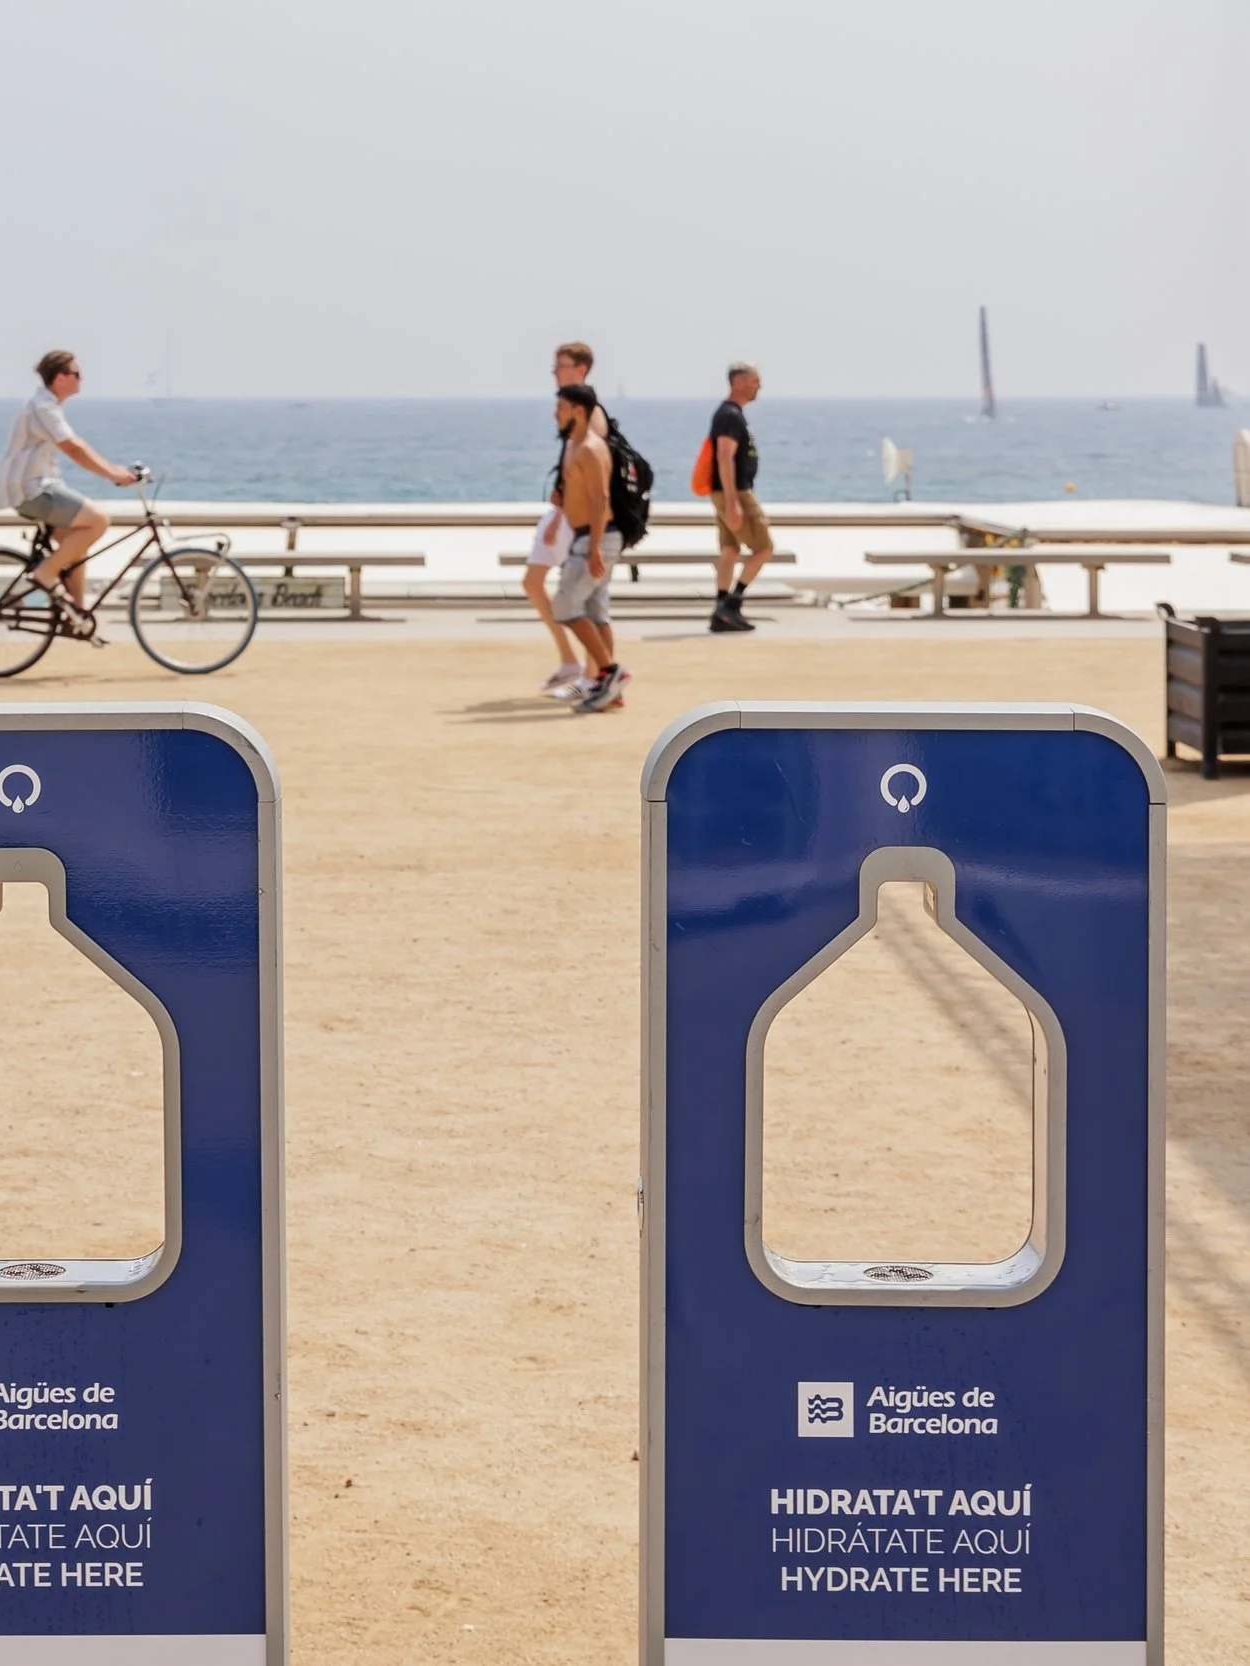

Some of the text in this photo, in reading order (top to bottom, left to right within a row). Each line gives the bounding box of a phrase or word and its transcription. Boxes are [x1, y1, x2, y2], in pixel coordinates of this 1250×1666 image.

[82, 1382, 116, 1404] de
[867, 1386, 996, 1414] Aigües de
[868, 1413, 999, 1435] Barcelona
[69, 1477, 153, 1512] AQUÍ
[770, 1483, 1033, 1517] HIDRATA'T AQUÍ
[74, 1516, 152, 1550] AQUÍ
[772, 1521, 1031, 1555] HIDRÁTATE AQUÍ
[61, 1562, 144, 1587] HERE
[781, 1566, 1023, 1593] HYDRATE HERE
